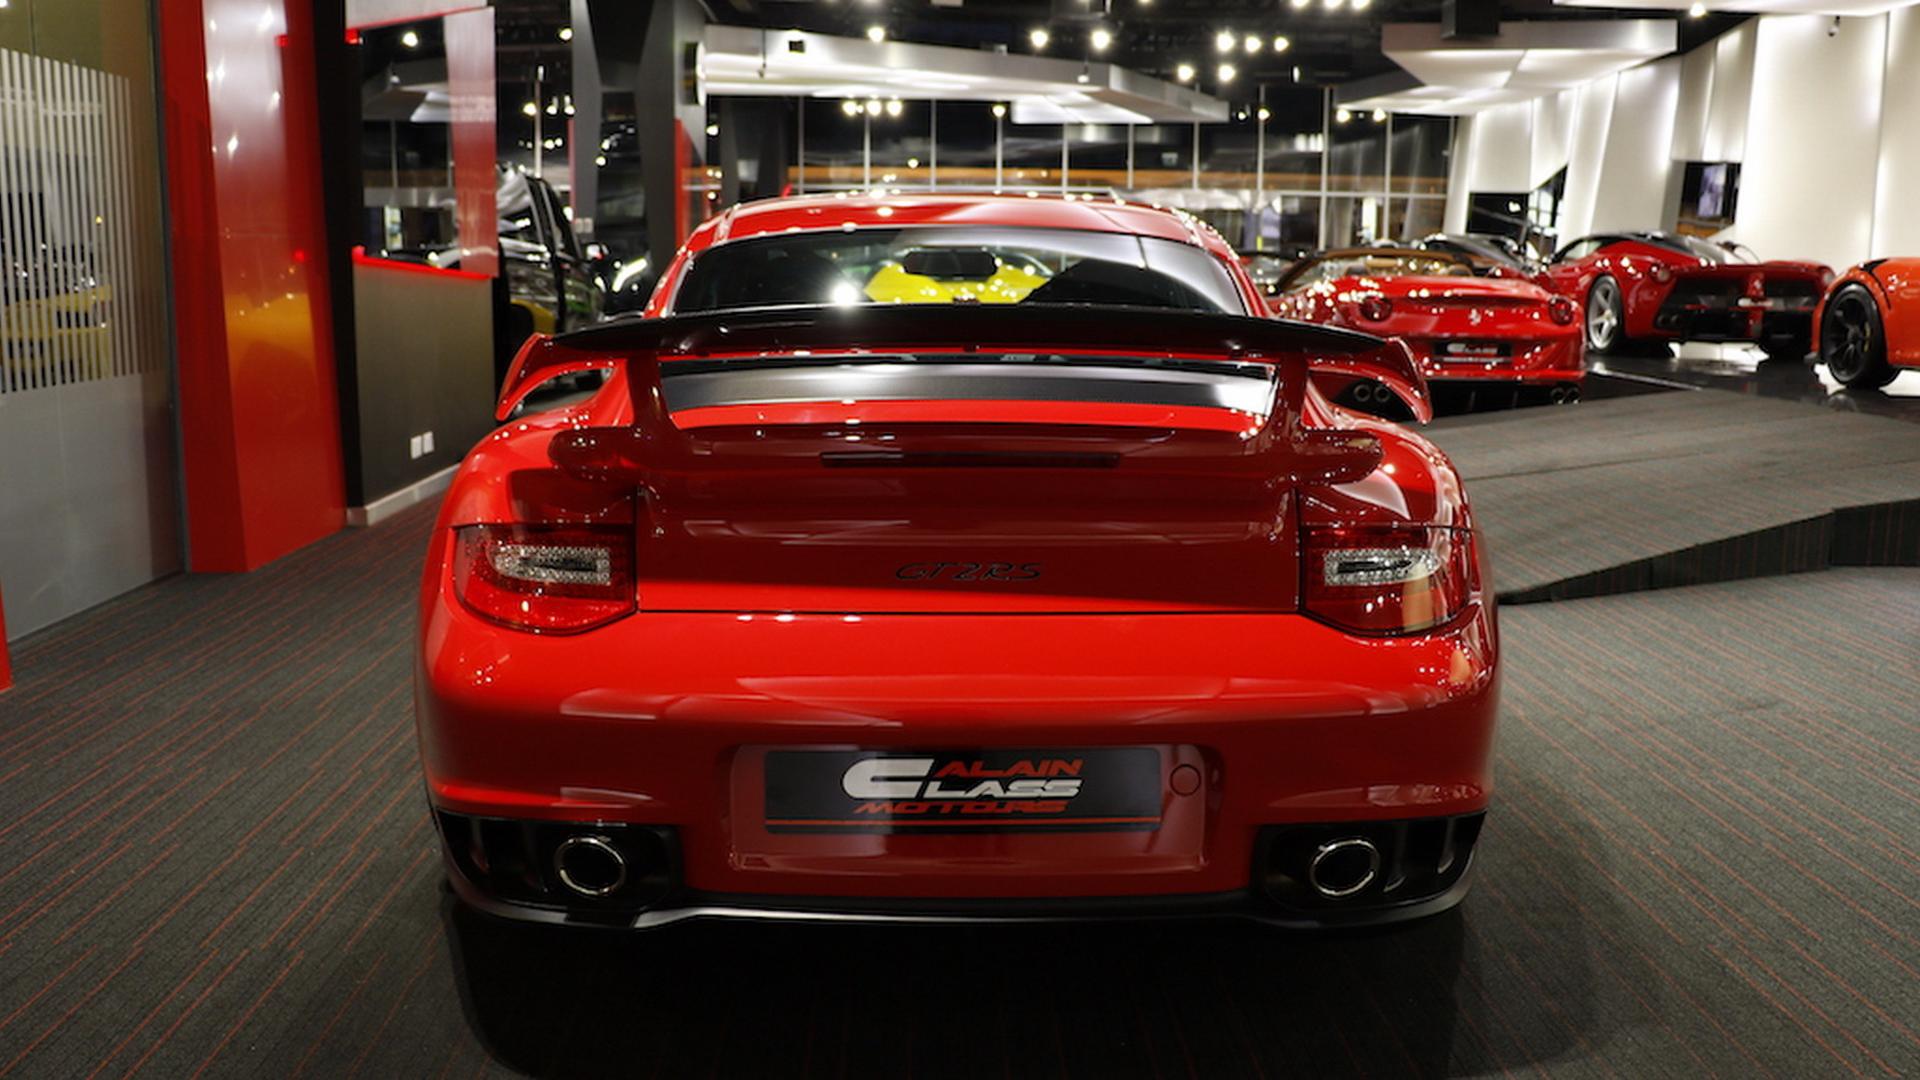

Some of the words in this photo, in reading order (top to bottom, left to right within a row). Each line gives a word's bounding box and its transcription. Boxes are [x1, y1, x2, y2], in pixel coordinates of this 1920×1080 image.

[841, 757, 1085, 799] CLASS
[933, 758, 1085, 778] ALAIN
[853, 800, 1071, 815] MOTORS
